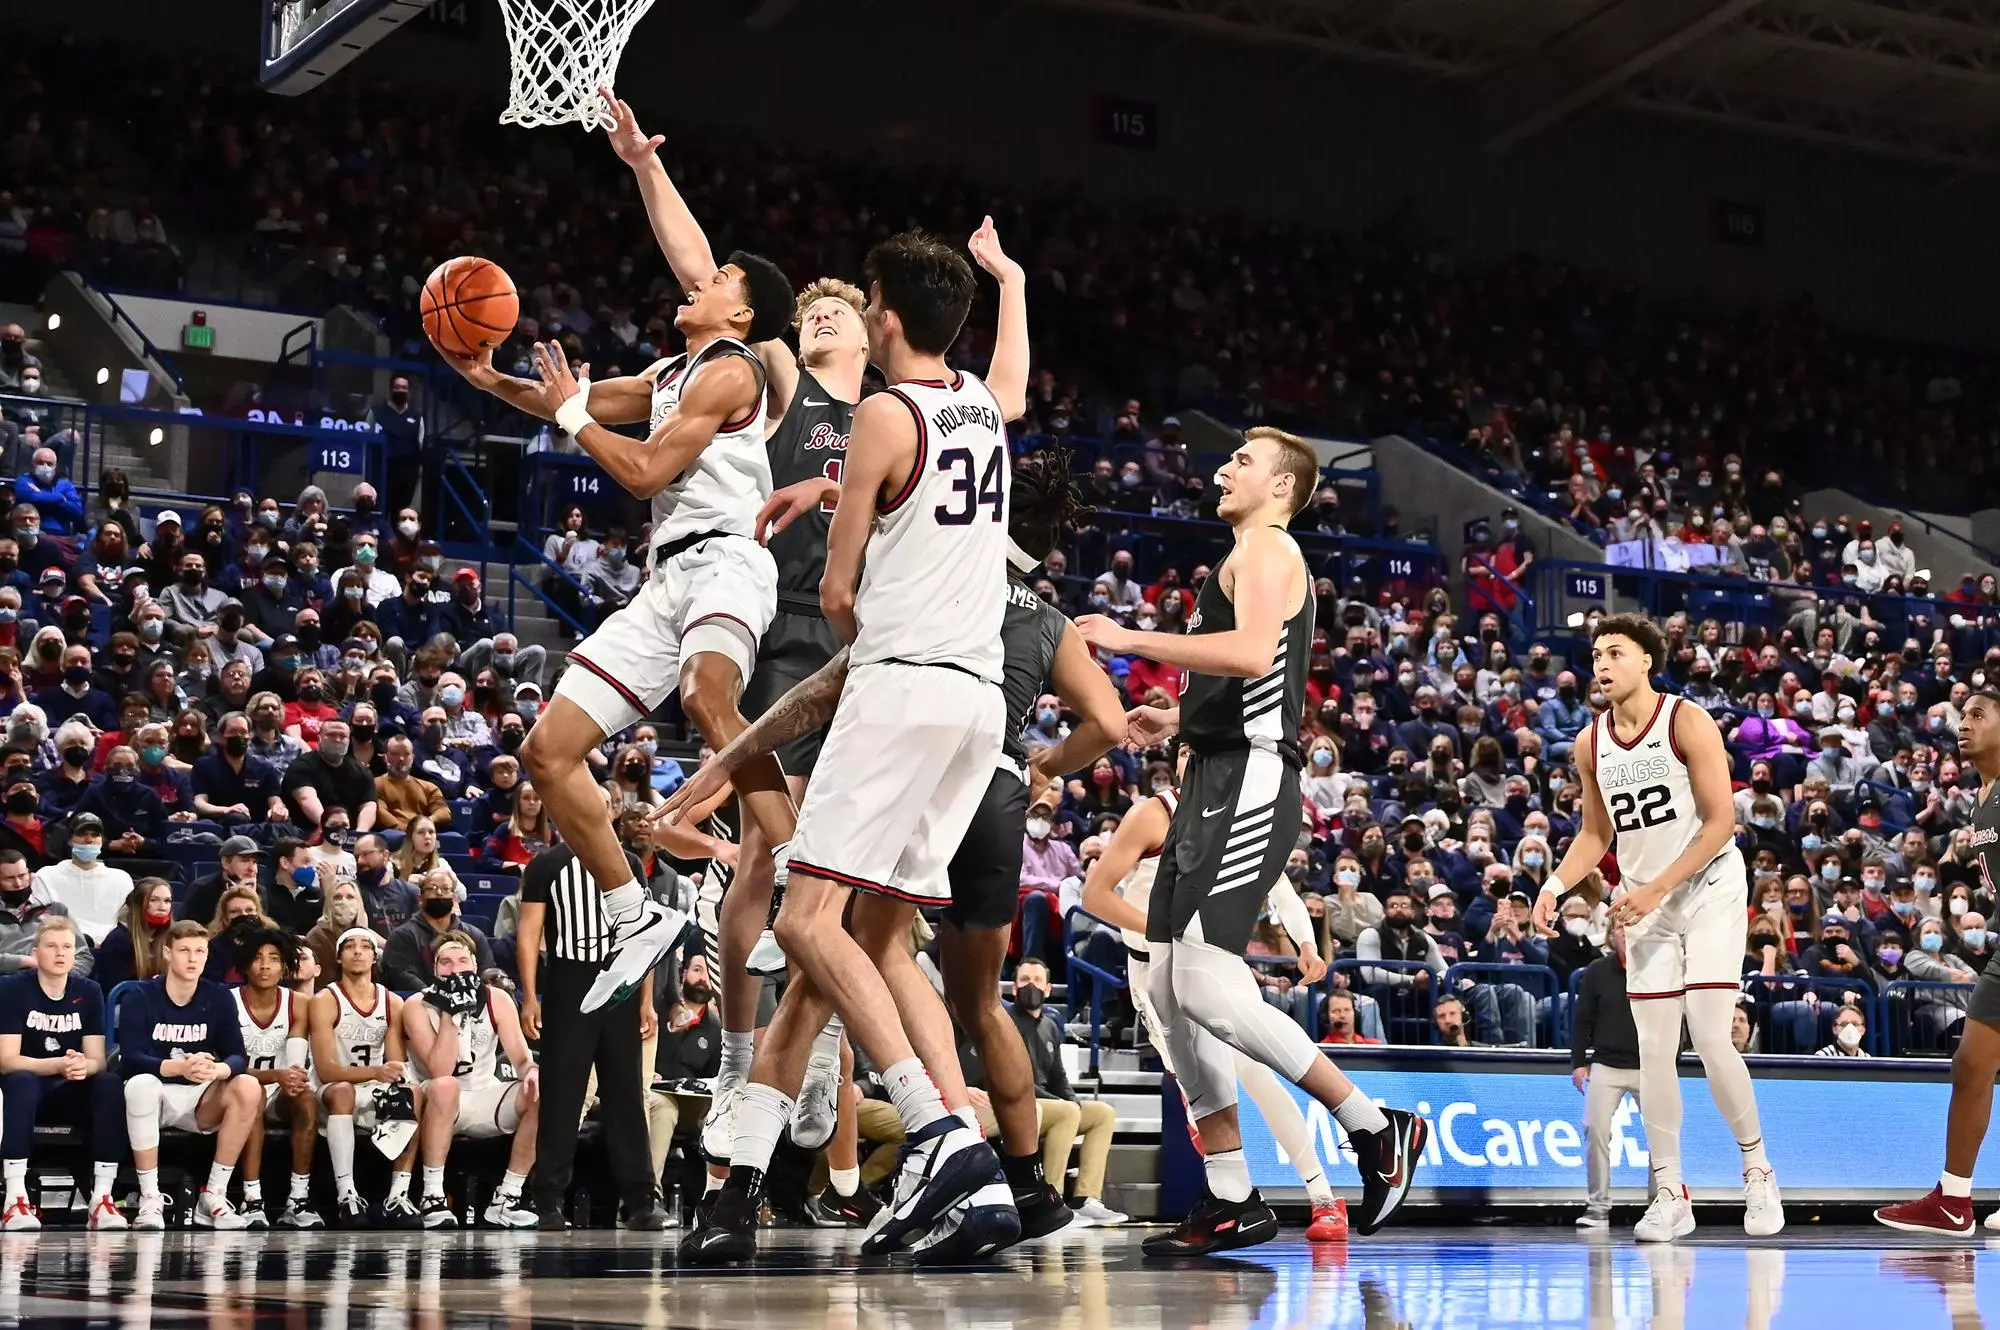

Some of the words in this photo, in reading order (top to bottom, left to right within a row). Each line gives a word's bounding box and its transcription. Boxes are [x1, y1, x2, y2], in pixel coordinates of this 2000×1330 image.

[1112, 111, 1145, 136] 115
[932, 403, 999, 438] HOLMGREN
[804, 422, 851, 450] Bro
[321, 449, 351, 468] 113
[572, 475, 600, 494] 114
[934, 445, 1004, 526] 34
[1389, 559, 1412, 576] 114
[1575, 579, 1598, 595] 115
[1601, 755, 1670, 790] ZAGS
[1610, 784, 1678, 833] 22
[26, 1009, 84, 1033] GONZAGA
[152, 1022, 208, 1043] GONZAGA
[350, 1045, 371, 1067] 3
